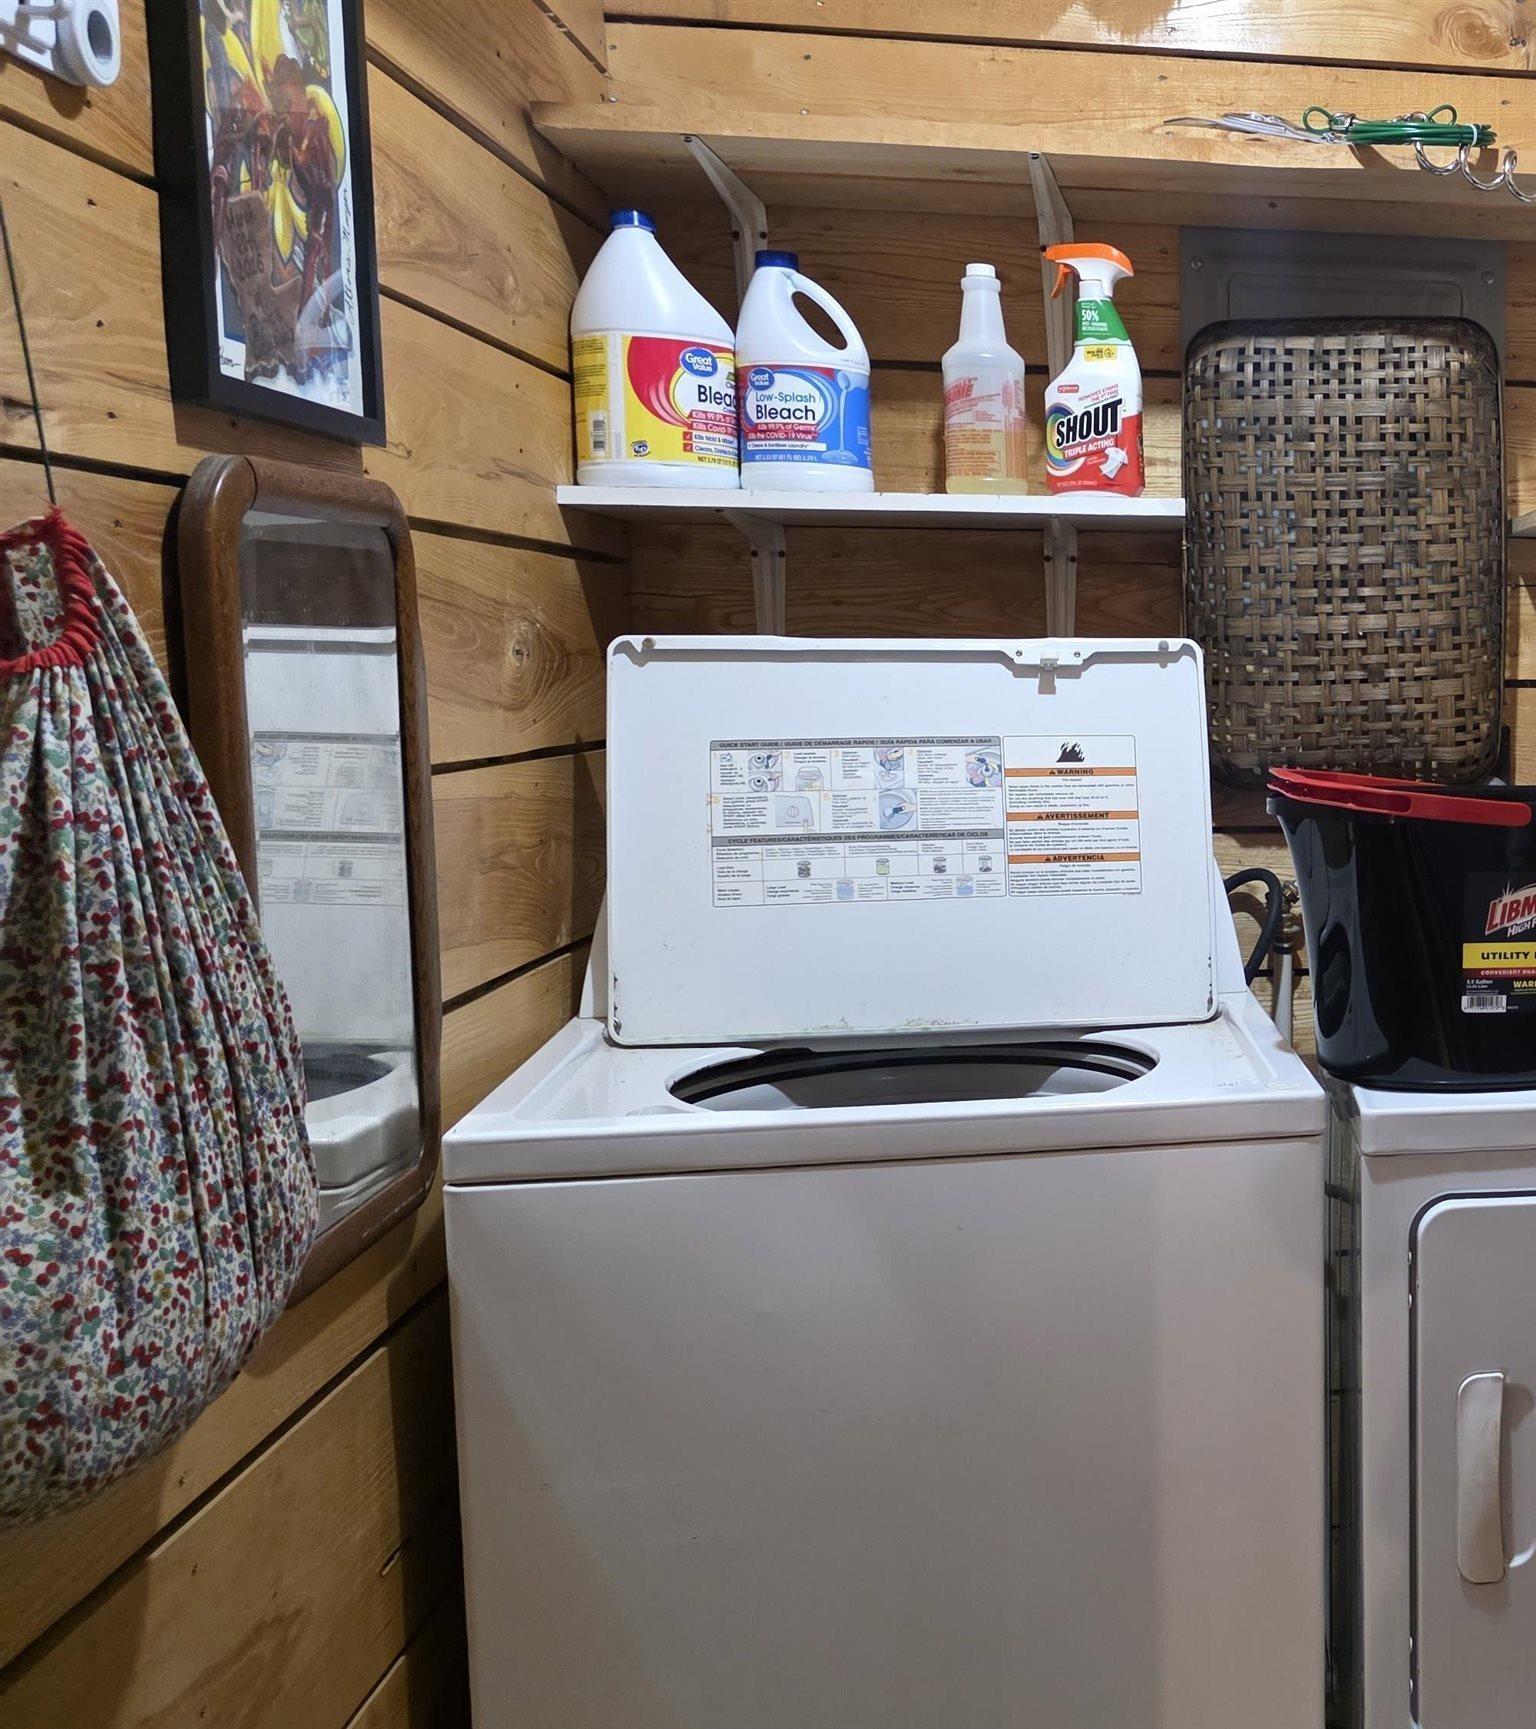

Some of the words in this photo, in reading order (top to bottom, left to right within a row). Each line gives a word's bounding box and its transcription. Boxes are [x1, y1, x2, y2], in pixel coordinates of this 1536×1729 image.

[685, 352, 713, 367] Great
[751, 373, 769, 382] Great
[697, 384, 738, 409] Bleac
[755, 392, 816, 404] Low-Splash
[756, 404, 816, 421] Bleach
[1055, 398, 1123, 447] SHOUT
[1064, 445, 1088, 458] TRIPLE
[1087, 438, 1115, 452] ACTING
[1052, 854, 1105, 862] ADVERTENCIA
[1507, 922, 1531, 938] HIGH
[1481, 951, 1529, 960] UTILITY
